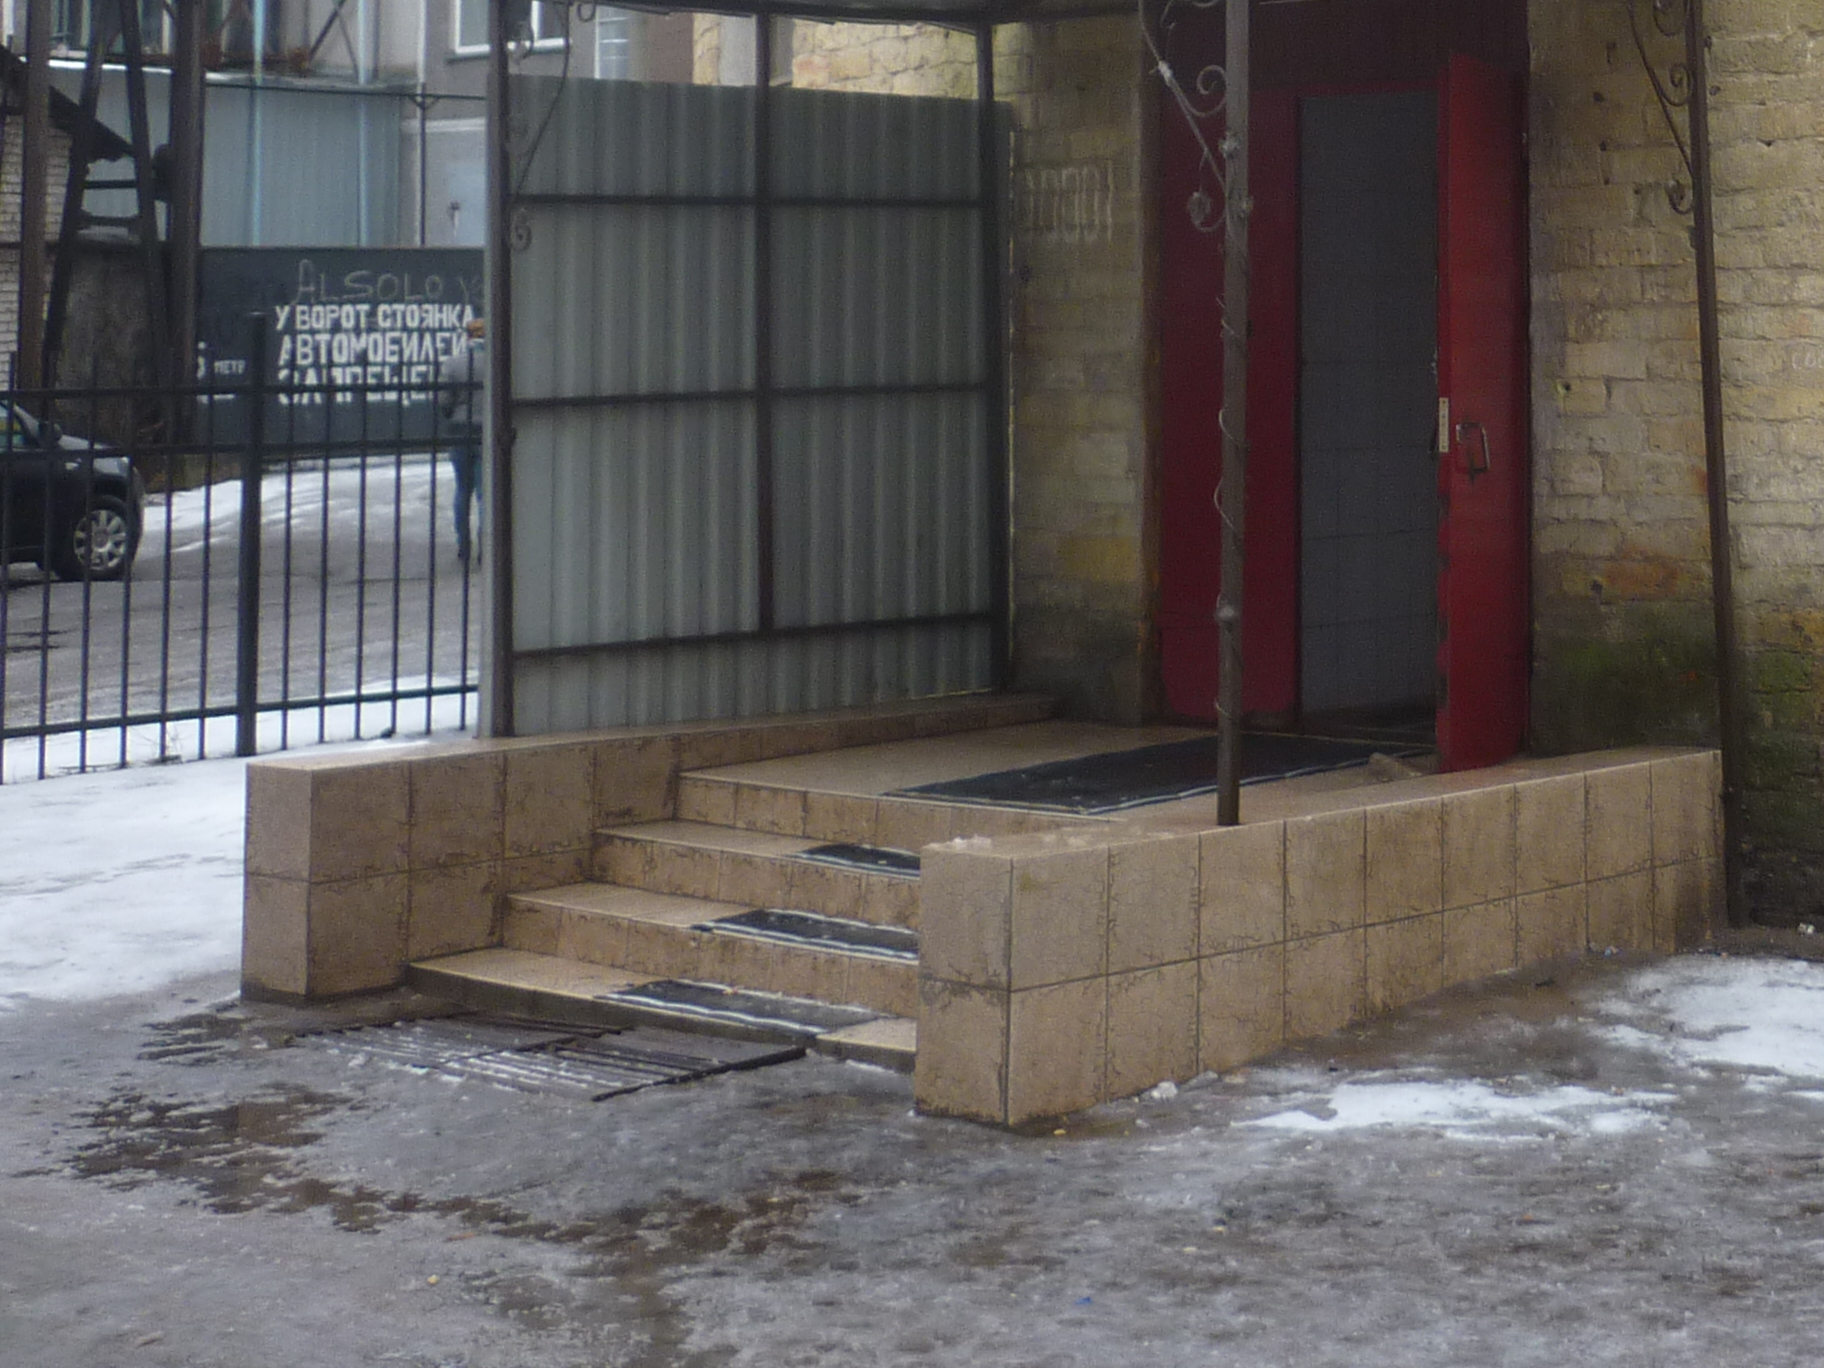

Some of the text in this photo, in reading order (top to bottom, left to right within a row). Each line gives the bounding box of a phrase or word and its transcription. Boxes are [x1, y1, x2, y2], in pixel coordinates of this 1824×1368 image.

[275, 303, 475, 330] У ВОРОТ СТОЯНКА
[279, 328, 468, 366] АВТОМОБИЛЕЙ
